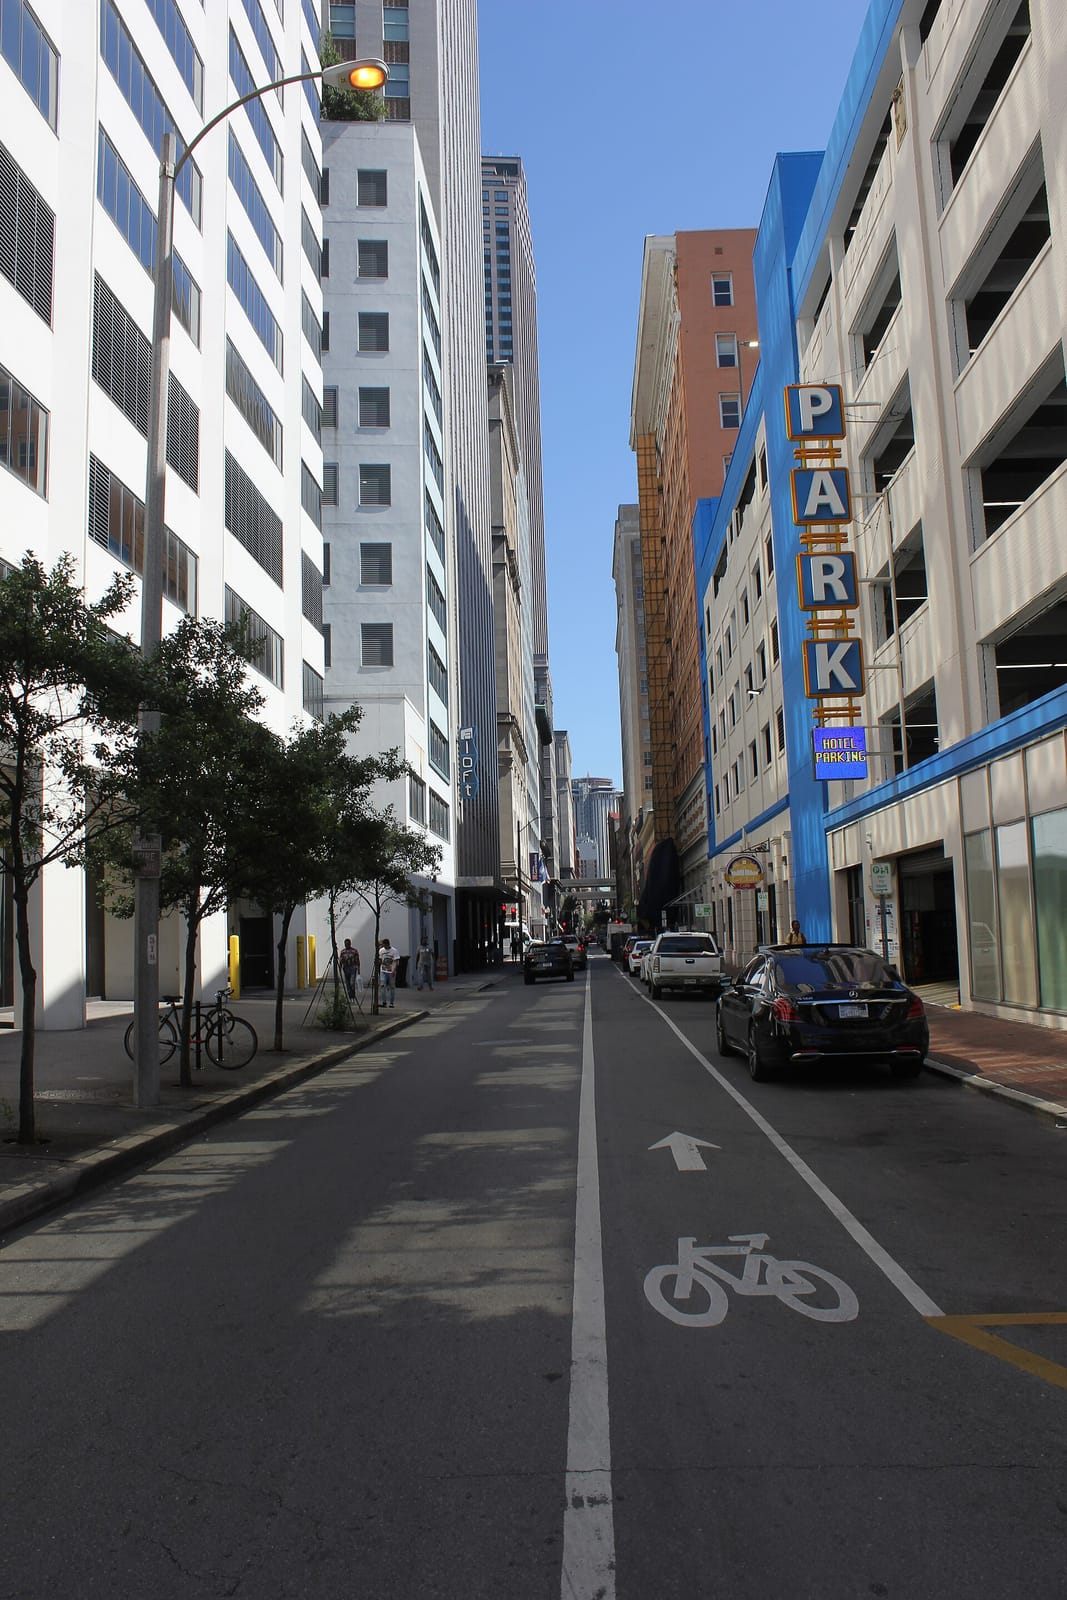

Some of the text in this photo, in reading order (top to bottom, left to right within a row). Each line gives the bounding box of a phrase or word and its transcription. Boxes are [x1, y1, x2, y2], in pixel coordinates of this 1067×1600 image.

[799, 387, 857, 690] PARK
[822, 737, 857, 750] HOTEL
[815, 750, 866, 763] PARKING
